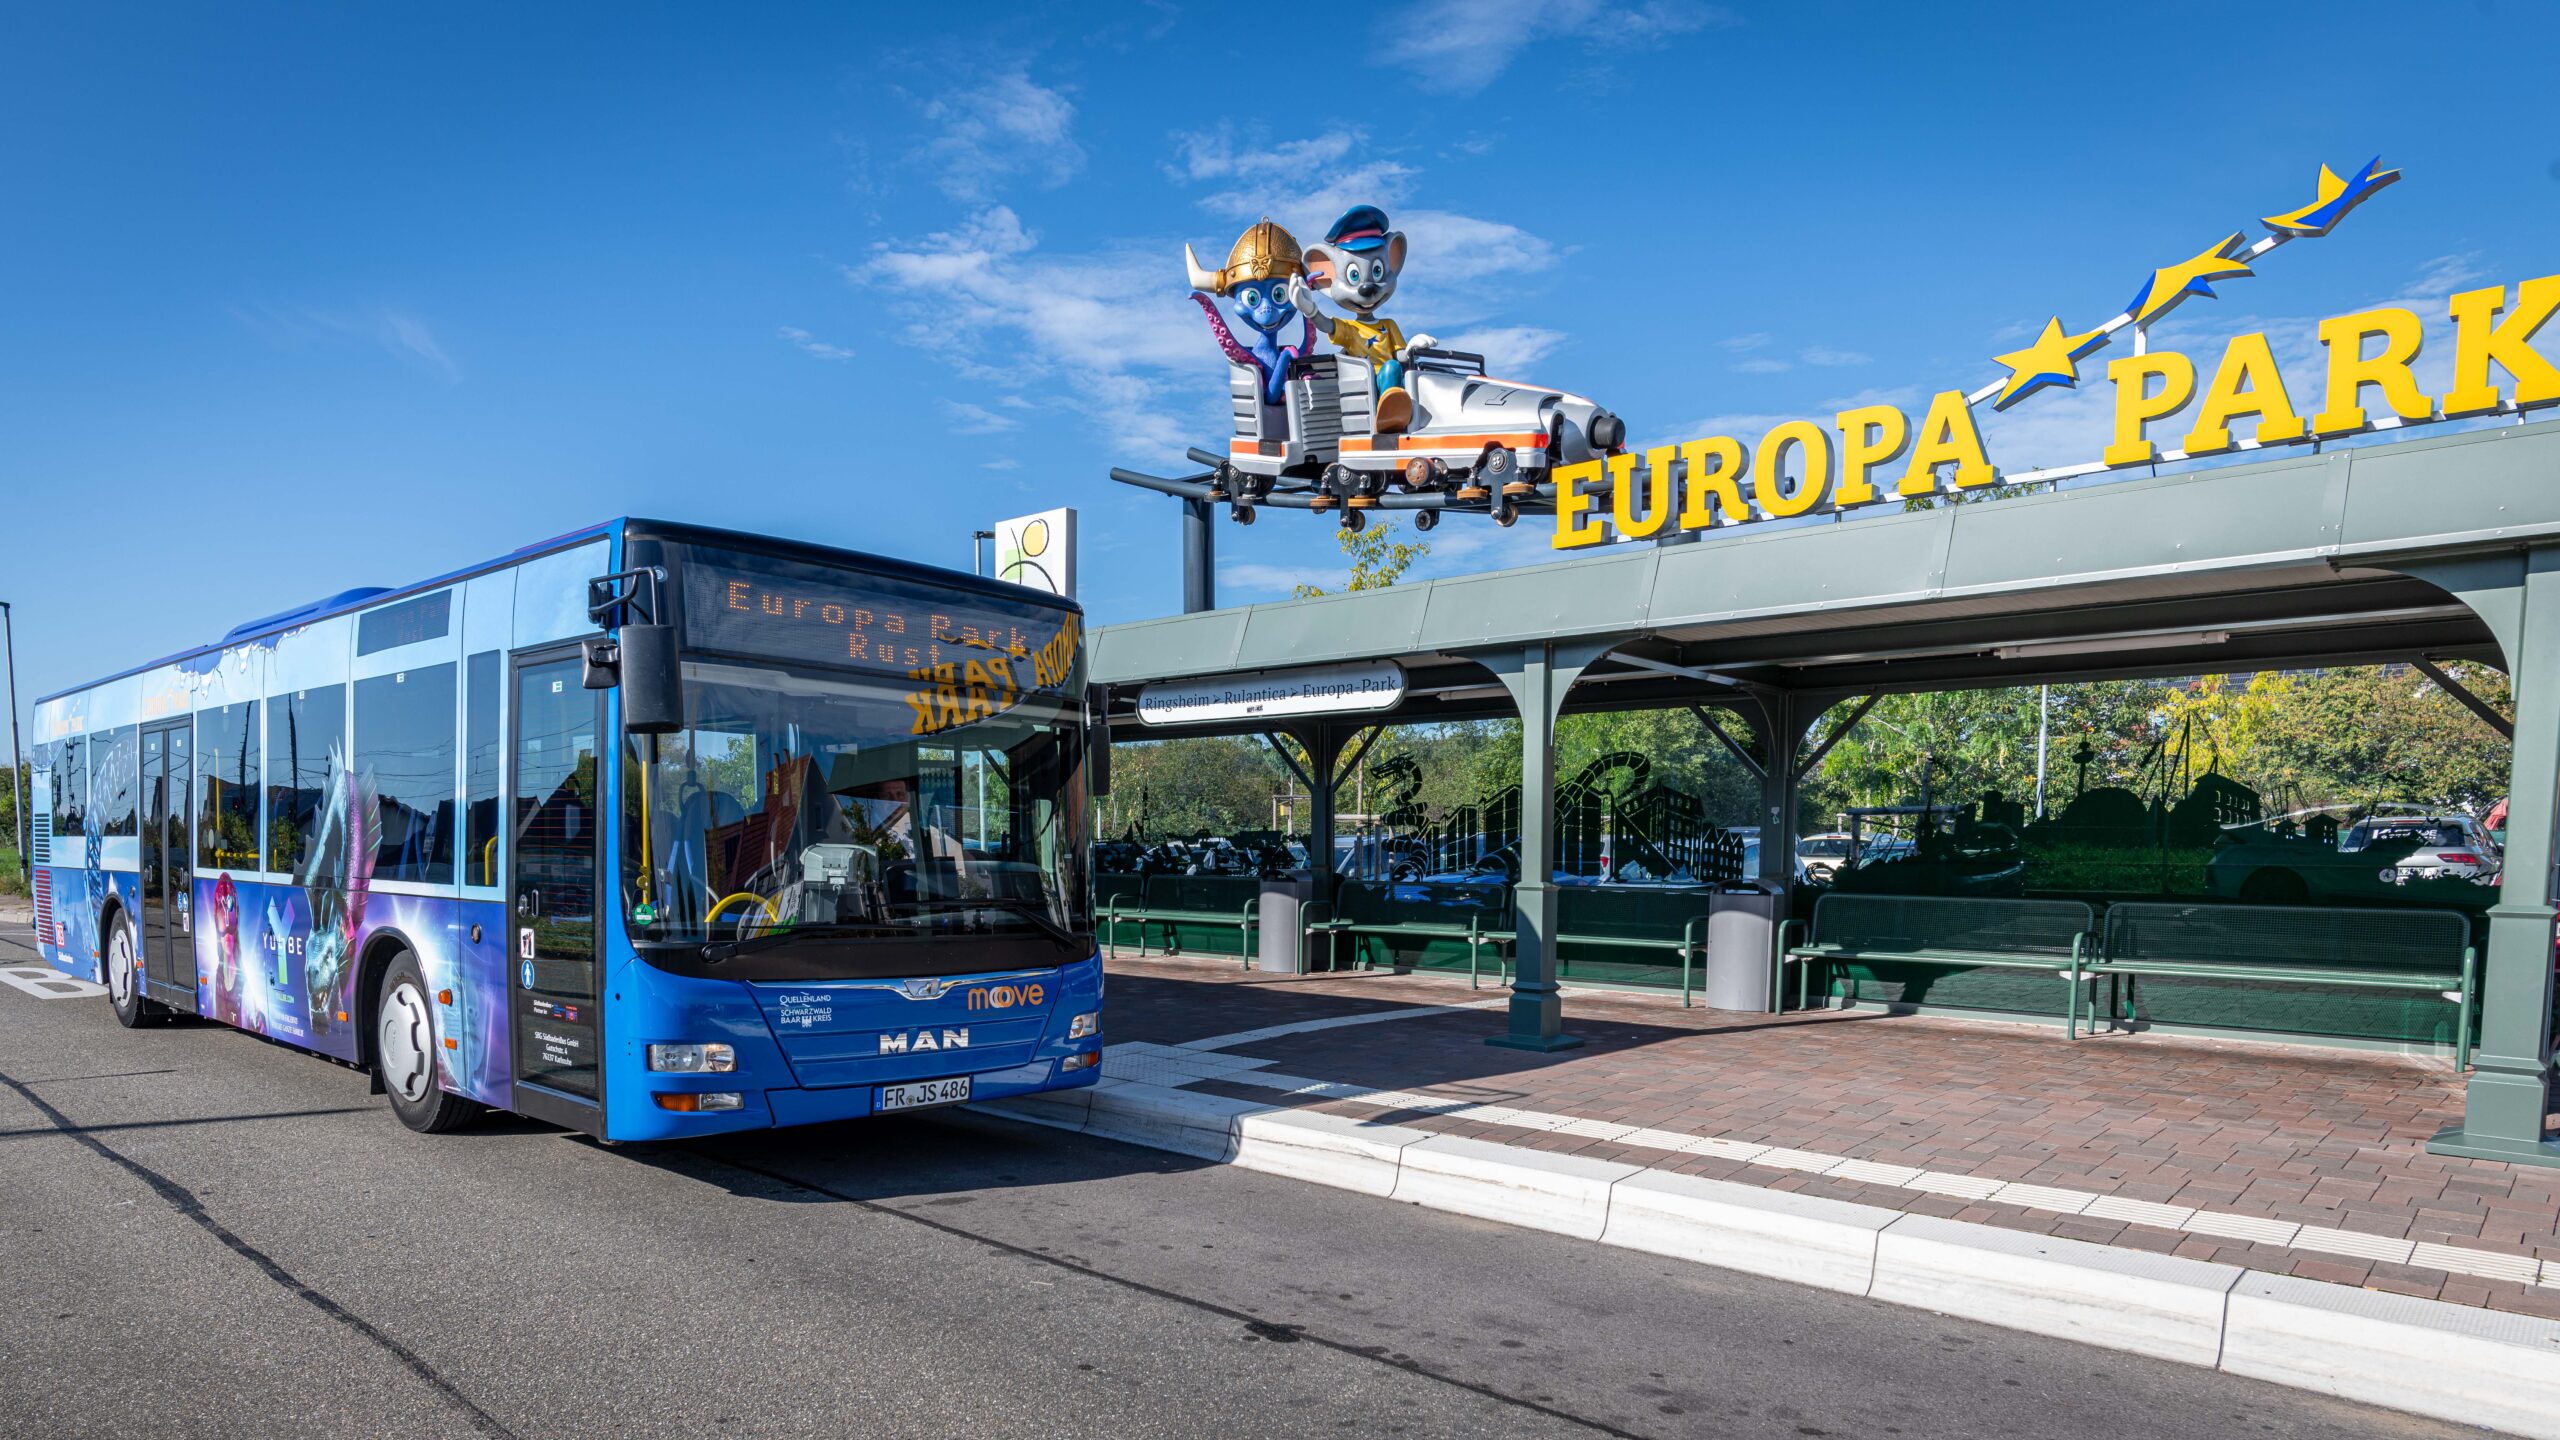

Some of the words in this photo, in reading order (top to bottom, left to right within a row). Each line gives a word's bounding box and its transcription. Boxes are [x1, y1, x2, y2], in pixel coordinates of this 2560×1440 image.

[1552, 390, 1999, 550] EUROPA
[2104, 275, 2560, 468] PARK
[729, 581, 904, 633] Europa
[931, 614, 1027, 652] Park
[850, 632, 944, 668] Rust
[1145, 694, 1209, 713] Ringsheim
[1224, 687, 1286, 705] Rulantica
[1303, 676, 1396, 699] Europa-Park
[781, 1007, 832, 1017] SCHWARZWALD
[781, 1016, 801, 1024] BAAR
[813, 1014, 832, 1022] KREIS
[879, 1027, 969, 1055] MAN
[884, 1087, 905, 1107] FR
[916, 1083, 937, 1103] JS
[940, 1080, 968, 1099] 486
